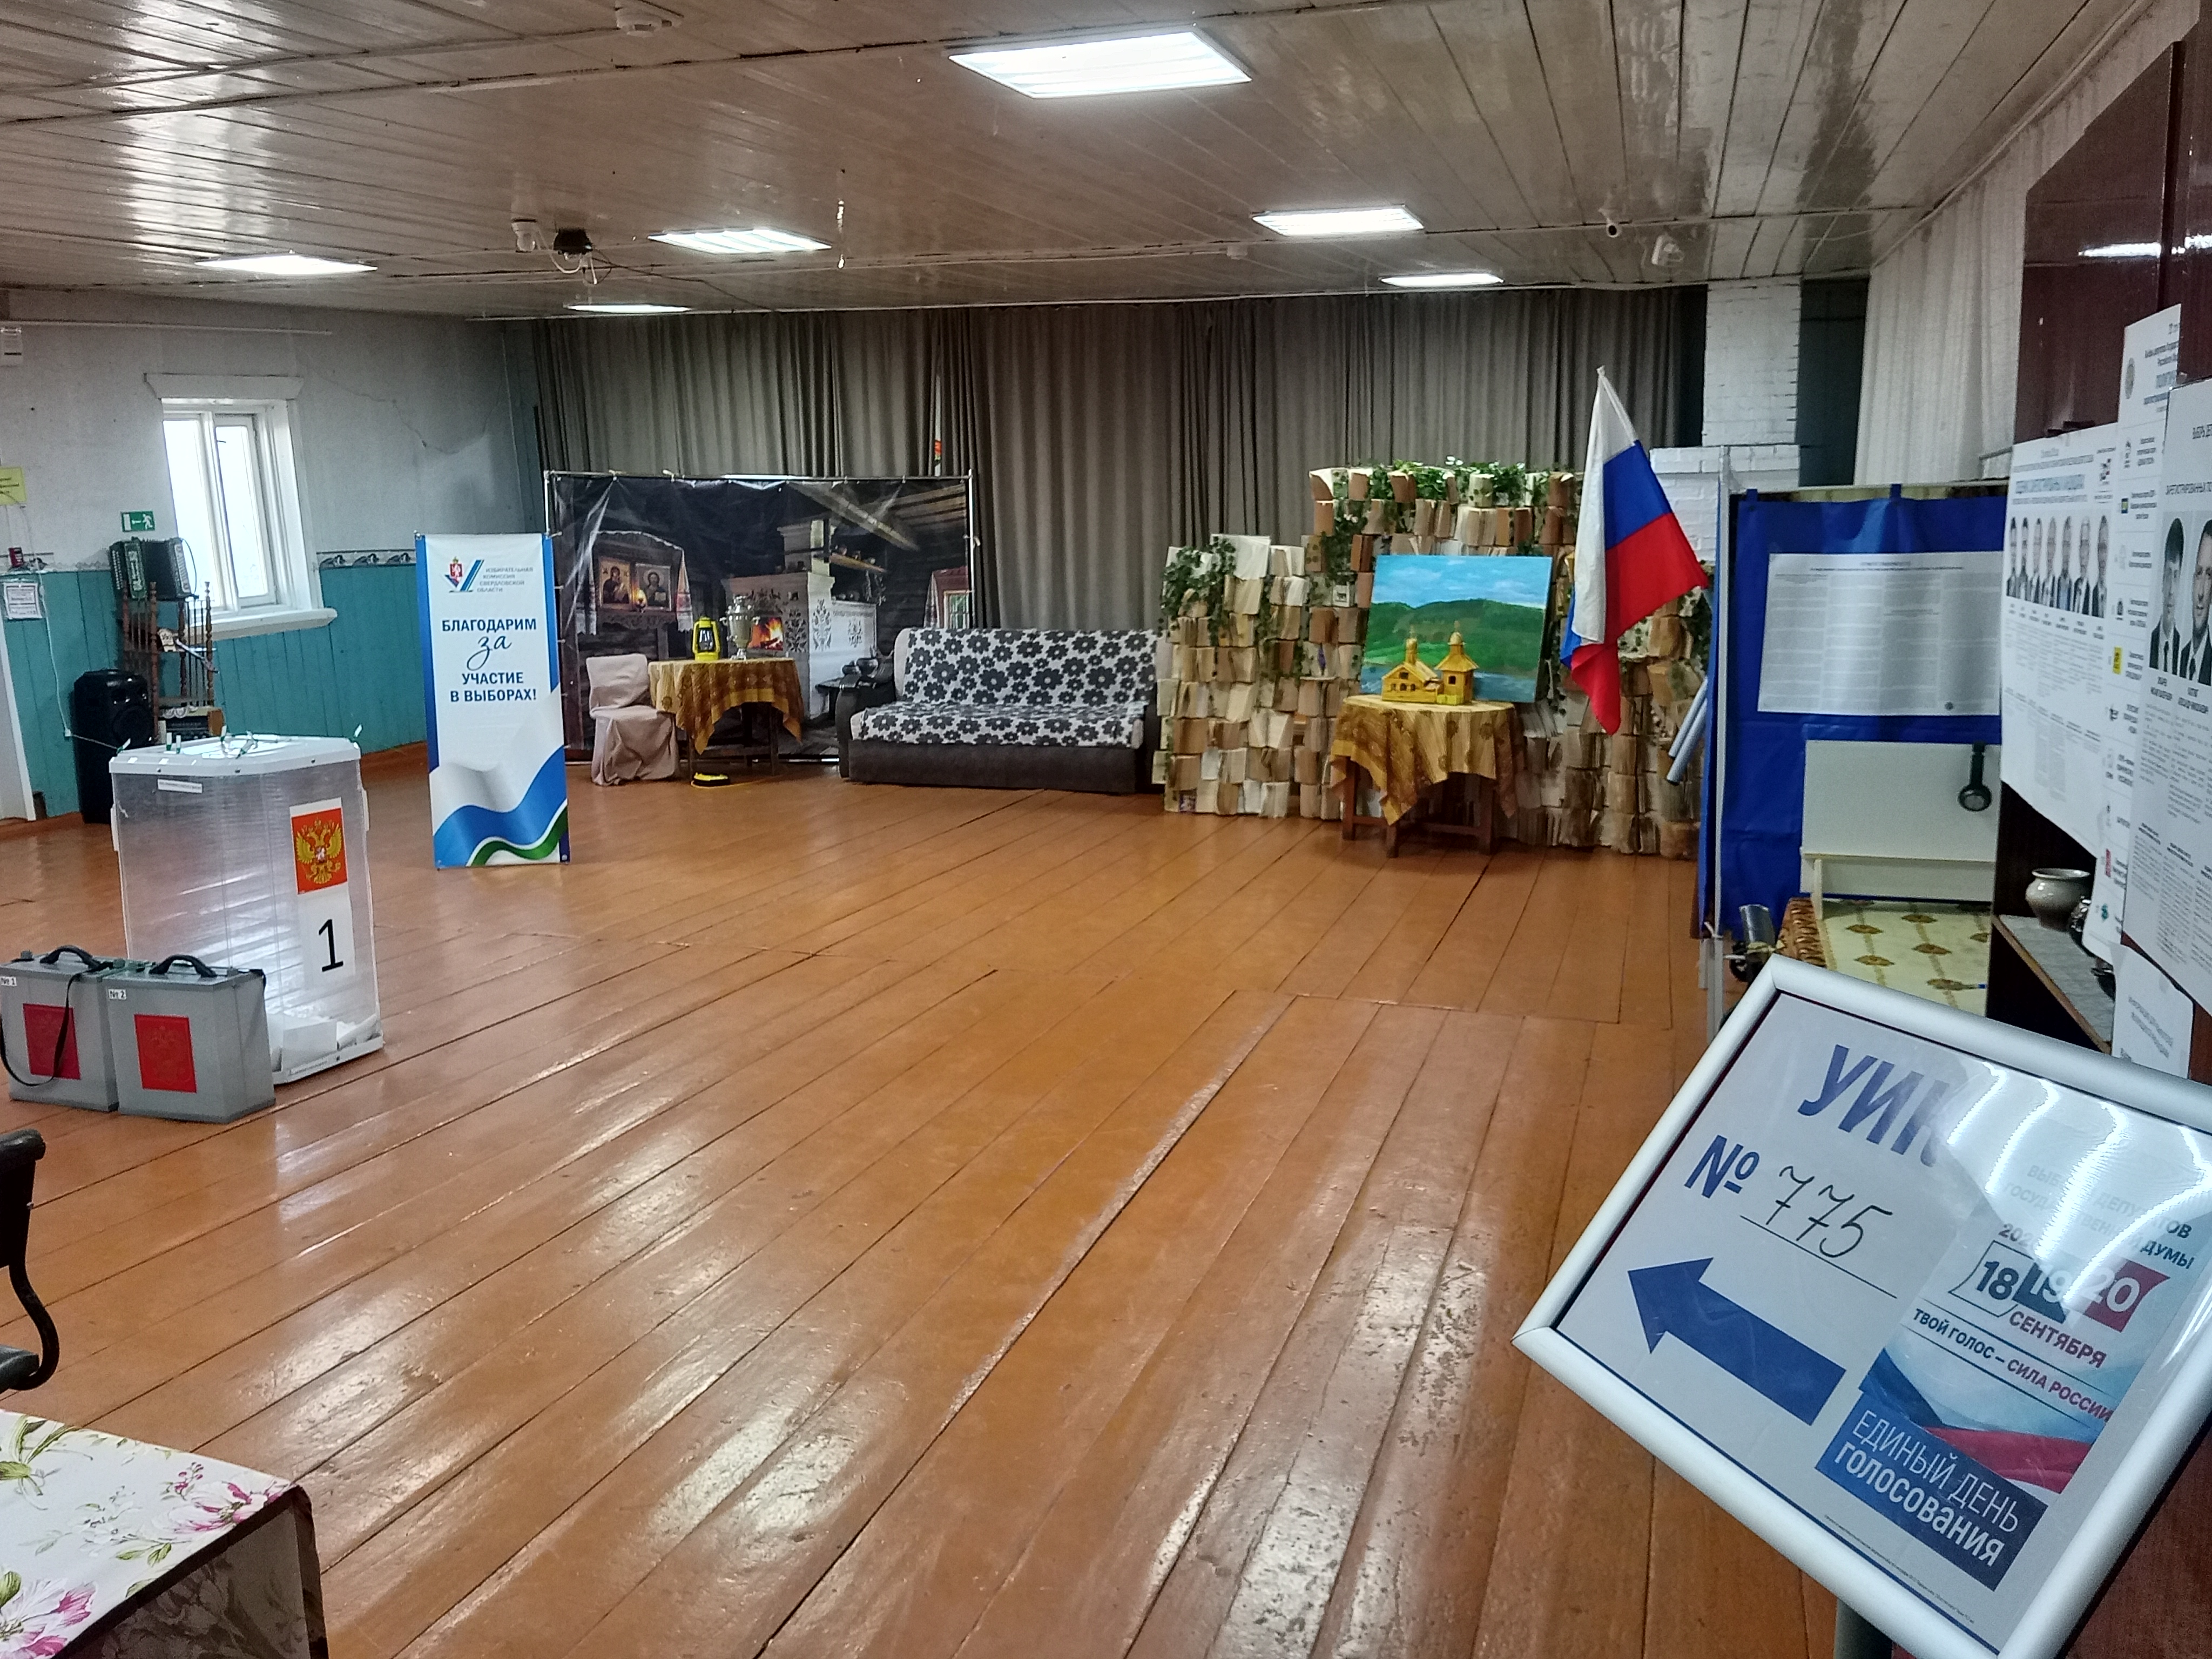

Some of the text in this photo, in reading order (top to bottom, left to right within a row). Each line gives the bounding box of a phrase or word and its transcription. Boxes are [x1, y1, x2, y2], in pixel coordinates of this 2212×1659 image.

[442, 618, 536, 633] БЛАГОДАРИМ
[467, 636, 512, 671] за
[450, 689, 536, 702] В ВЫБОРАХ!
[462, 672, 524, 685] УЧАСТИЕ
[319, 919, 343, 972] 1
[120, 990, 125, 999] 2
[1684, 1135, 1893, 1258] № 775
[2140, 1240, 2195, 1270] ДУМЫ
[1975, 1260, 2020, 1300] 18
[2081, 1267, 2141, 1313] 20
[2009, 1311, 2107, 1368] СЕНТЯБРЯ
[1913, 1308, 1950, 1335] ТВОЙ
[1947, 1328, 1995, 1359] ГОЛОС
[2007, 1359, 2047, 1389] СИЛА
[2048, 1381, 2115, 1423] РОССИИ
[1853, 1410, 2019, 1533] ЕДИНЫЙ ДЕНЬ
